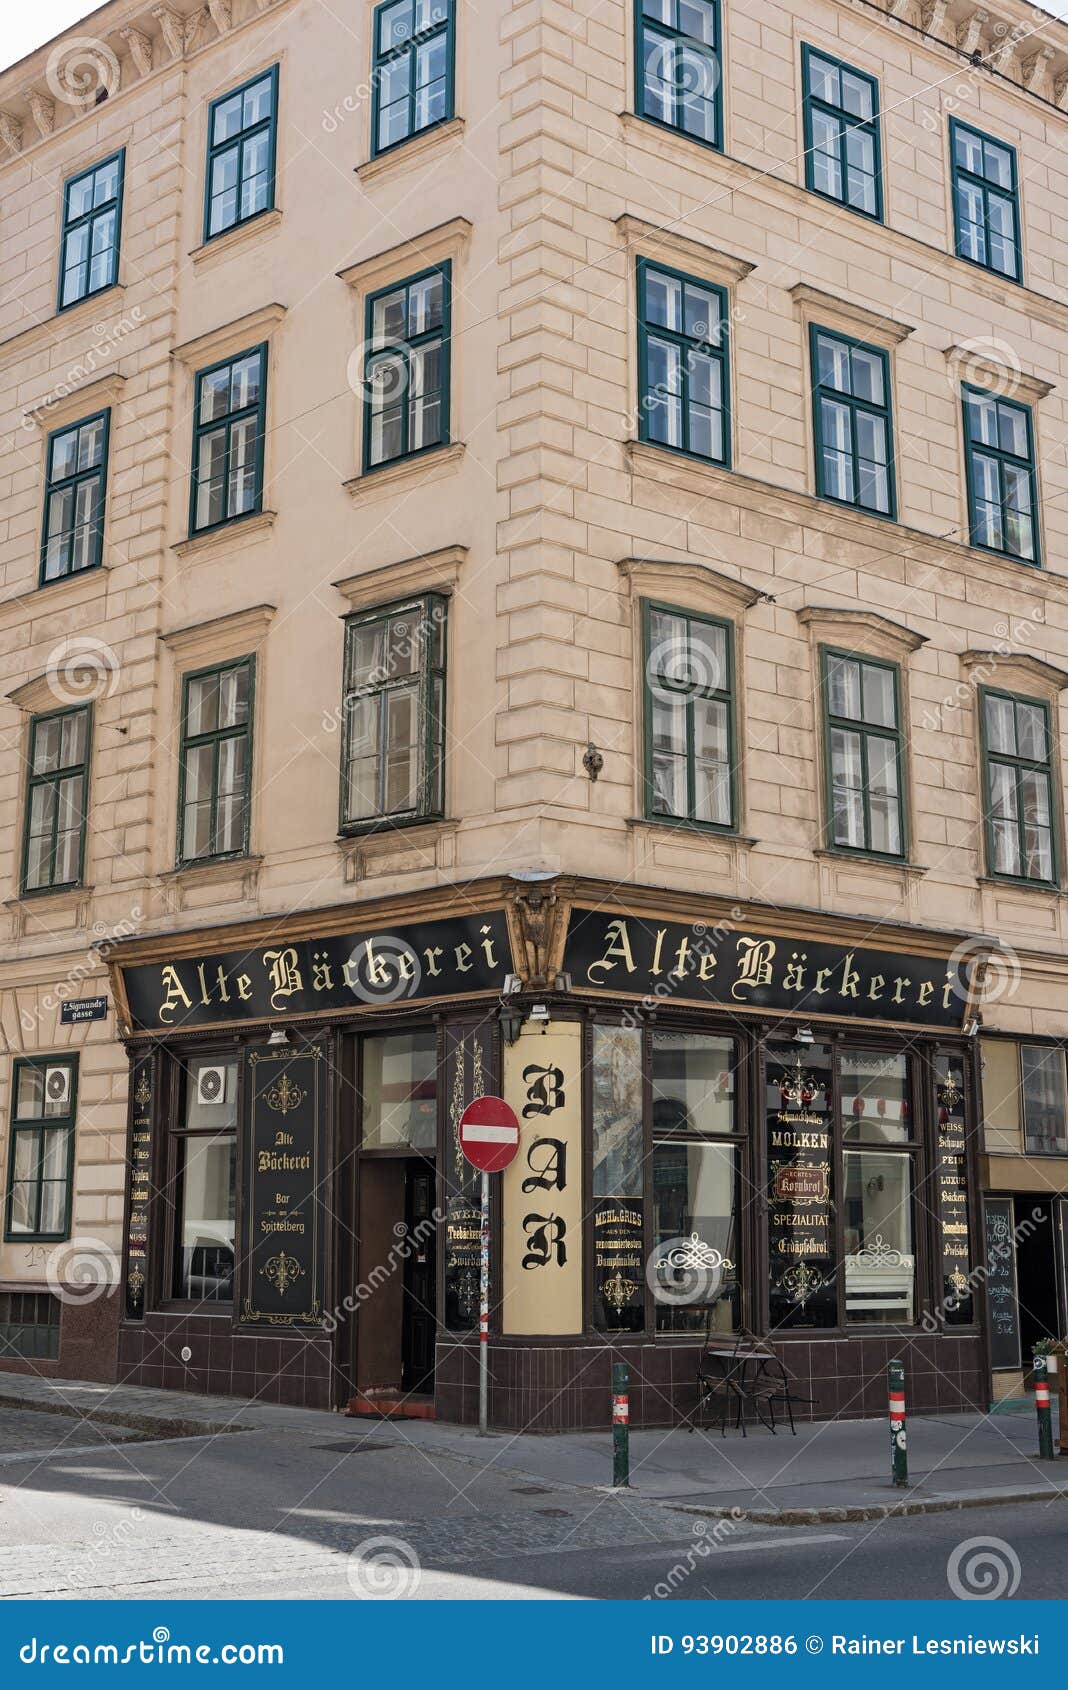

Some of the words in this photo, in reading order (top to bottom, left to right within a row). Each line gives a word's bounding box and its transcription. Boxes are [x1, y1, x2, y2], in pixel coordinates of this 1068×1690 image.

[587, 920, 717, 985] Alte
[731, 936, 953, 1009] Bäckerei
[159, 962, 253, 1023] Alte
[263, 925, 499, 1011] Bäckerei
[72, 1010, 93, 1020] gasse
[940, 1122, 963, 1132] WEISS
[275, 1131, 294, 1145] Alte
[772, 1131, 829, 1149] MOLKEN
[258, 1150, 311, 1172] Bäckerei
[522, 1063, 567, 1270] BAR
[781, 1178, 821, 1193] Kornbrot
[941, 1176, 967, 1185] LUXUS
[276, 1193, 291, 1204] Bar
[261, 1221, 305, 1234] Spittelberg
[448, 1226, 482, 1240] Teebäckere
[129, 1233, 147, 1242] NUSS
